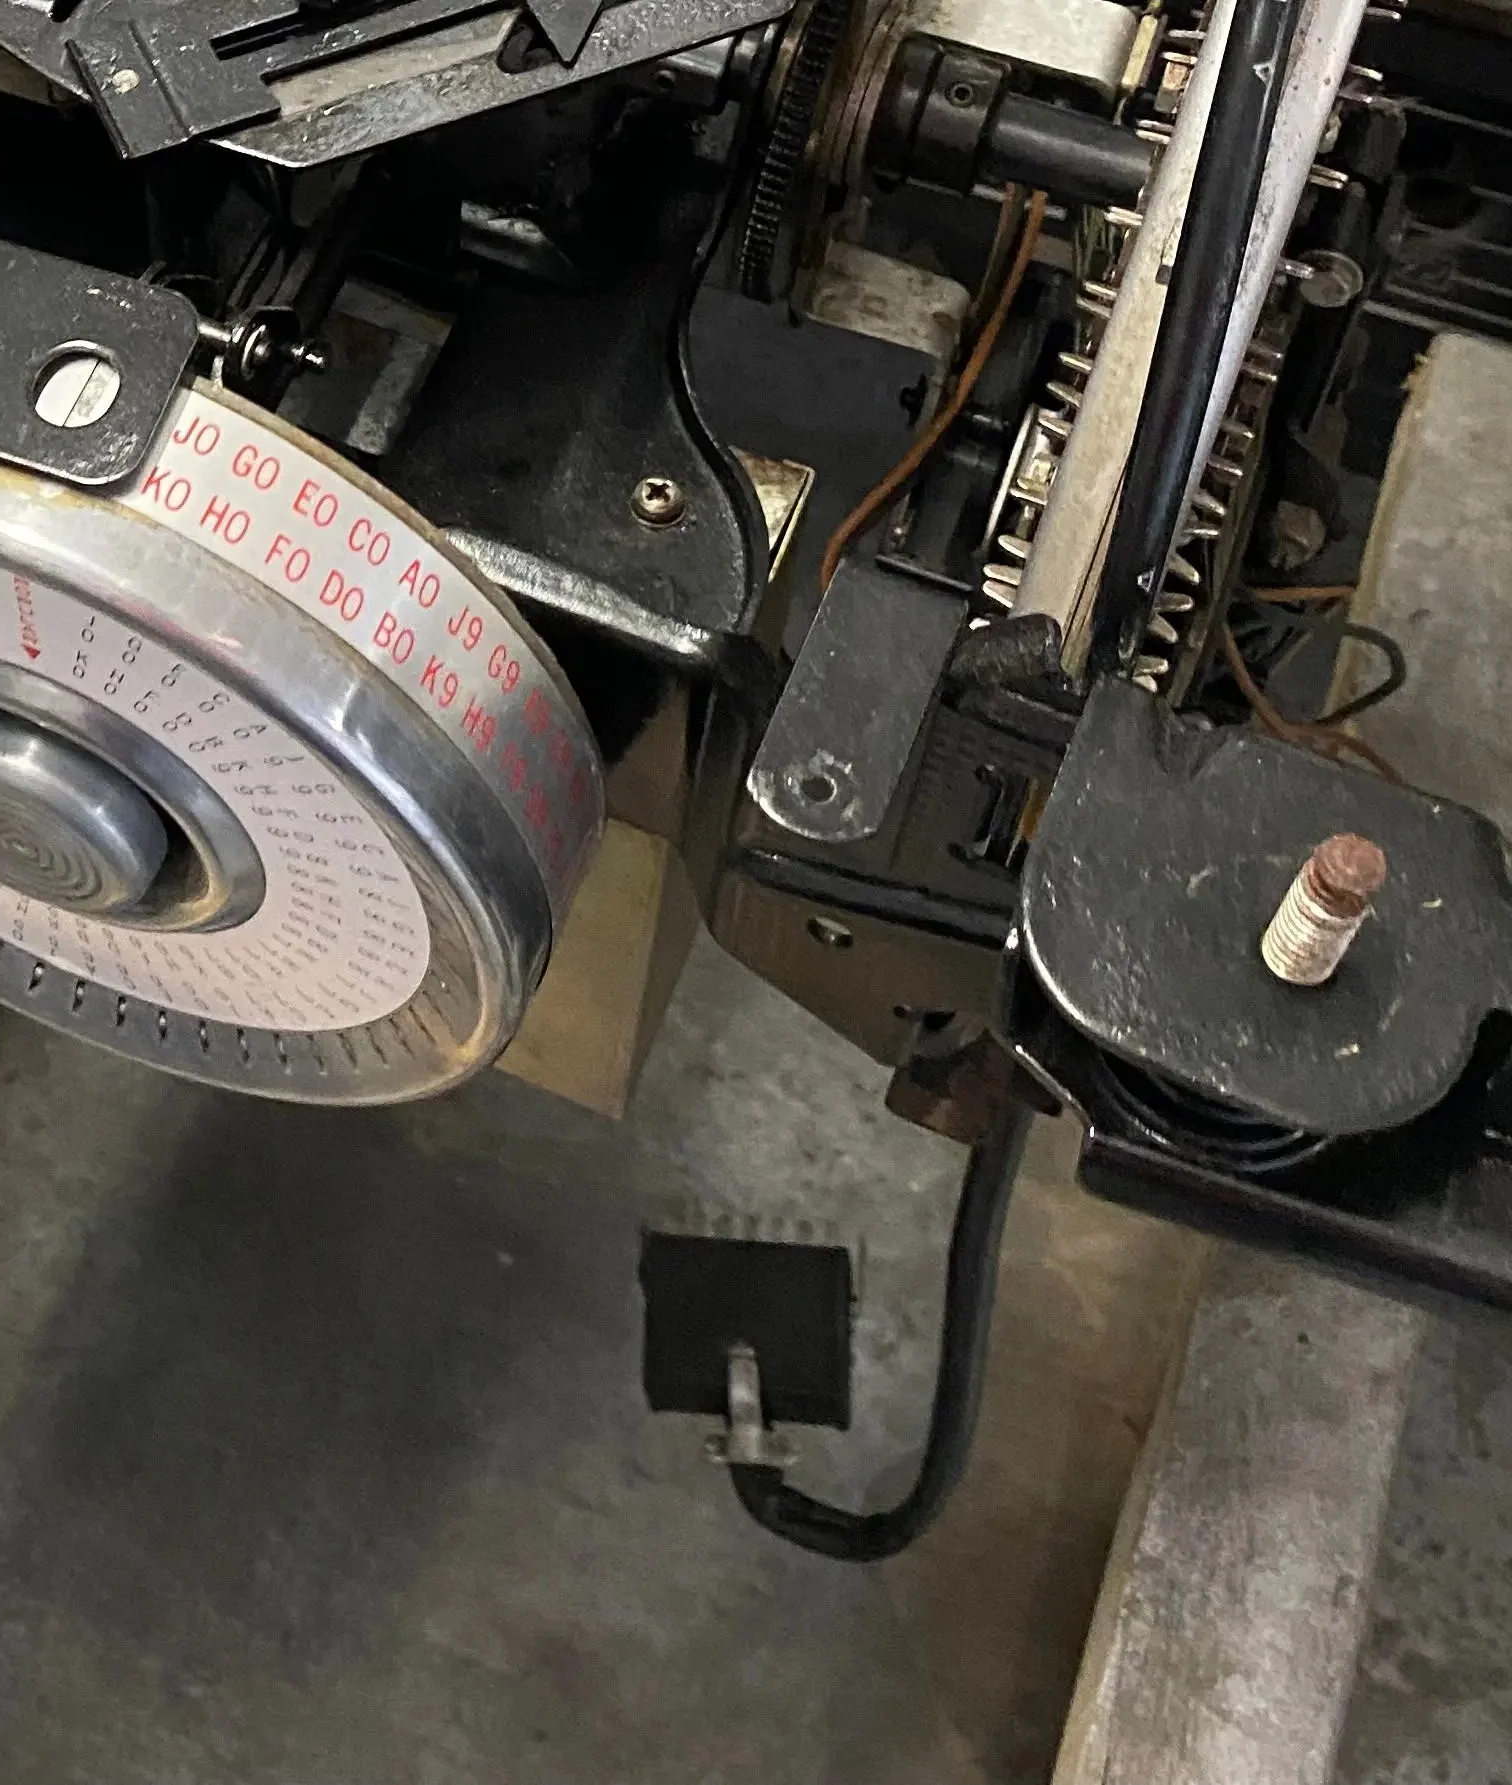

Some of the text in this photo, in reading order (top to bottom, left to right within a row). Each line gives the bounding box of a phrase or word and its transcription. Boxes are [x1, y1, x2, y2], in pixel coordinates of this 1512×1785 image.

[420, 653, 460, 708] K9
[447, 605, 484, 652] J9
[487, 644, 520, 695] G9
